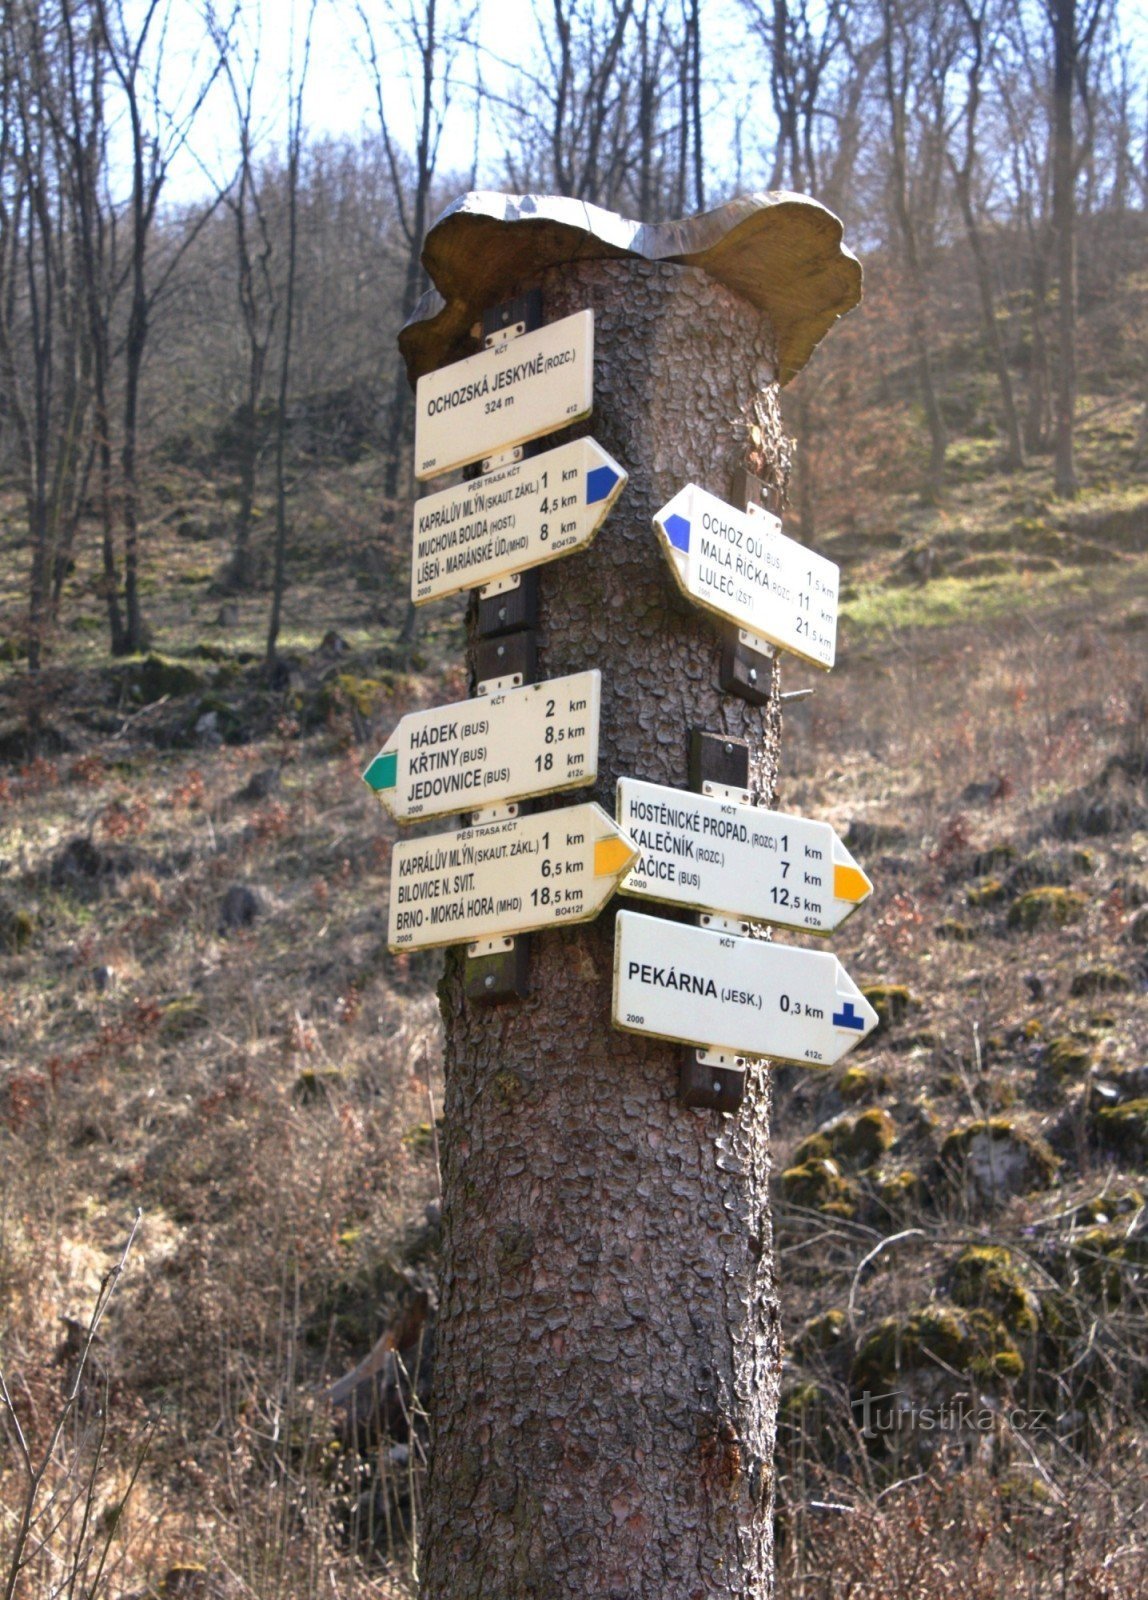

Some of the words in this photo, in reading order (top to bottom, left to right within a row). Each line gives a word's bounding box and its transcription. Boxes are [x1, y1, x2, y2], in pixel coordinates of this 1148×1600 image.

[495, 344, 507, 355] KČT
[427, 374, 489, 416] OCHOZSKÁ
[492, 353, 543, 391] JESKYNĚ
[485, 402, 501, 414] 324
[505, 396, 514, 406] m
[566, 404, 577, 413] 412
[482, 473, 506, 488] TRASA
[507, 467, 520, 479] KČT
[419, 502, 461, 534] KAPRÁLŮV
[463, 494, 484, 515] MLÝN
[541, 472, 548, 488] 1
[562, 468, 577, 482] km
[418, 532, 457, 557] MUCHOVA
[459, 520, 488, 549] BOUDA
[540, 497, 558, 514] 4,5
[562, 495, 577, 508] km
[446, 541, 492, 573] MARIÁNSKÉ
[540, 524, 548, 541] 8
[561, 521, 576, 534] km
[702, 513, 742, 548] OCHOZ
[822, 582, 834, 599] km
[700, 538, 732, 572] MALÁ
[736, 554, 769, 590] ŘÍČKA
[798, 592, 810, 611] 11
[820, 608, 833, 624] km
[699, 564, 734, 597] LULEČ
[819, 633, 832, 649] km
[410, 722, 457, 749] HÁDEK
[460, 720, 489, 740] (BUS)
[546, 700, 555, 717] 2
[569, 698, 587, 712] km
[490, 696, 505, 706] KČT
[409, 749, 459, 775] KŘTINY
[460, 747, 487, 766] (BUS)
[545, 726, 564, 744] 8,5
[568, 725, 585, 739] km
[407, 769, 481, 802] JEDOVNICE
[483, 768, 510, 787] (BUS)
[535, 753, 553, 772] 18
[567, 753, 584, 766] km
[567, 770, 584, 778] 412c
[407, 804, 423, 815] 2000
[475, 826, 500, 838] TRASA
[502, 822, 517, 833] KČT
[630, 800, 700, 832] HOSTĚNICKÉ
[703, 816, 750, 844] PROPAD.
[752, 832, 778, 850] (ROZC.)
[781, 835, 788, 852] 1
[804, 845, 822, 860] km
[720, 805, 736, 816] KČT
[399, 848, 447, 877] KAPRÁLŮV
[449, 844, 474, 867] MLÝN
[510, 839, 539, 857] ZÁKL.)
[542, 832, 550, 850] 1
[566, 832, 584, 846] km
[630, 828, 694, 858] KALEČNÍK
[695, 848, 725, 868] (ROZC.)
[780, 862, 790, 878] 7
[804, 872, 822, 887] km
[398, 879, 440, 904] BILOVICE
[442, 876, 451, 889] N.
[454, 872, 475, 892] SVIT.
[541, 859, 562, 877] 6,5
[566, 861, 584, 873] km
[629, 878, 647, 889] 2000
[632, 855, 675, 881] AČICE
[678, 871, 701, 889] (BUS)
[770, 887, 800, 909] 12,5
[804, 898, 822, 914] km
[396, 911, 423, 930] BRNO
[430, 895, 464, 924] MOKRÁ
[467, 896, 494, 917] HORA
[496, 898, 522, 916] (MHD)
[531, 886, 561, 906] 18,5
[565, 888, 583, 901] km
[396, 934, 413, 943] 2005
[719, 938, 735, 948] KČT
[628, 961, 717, 999] PEKÁRNA
[721, 988, 762, 1010] (JESK.)
[780, 994, 801, 1016] 0,3
[805, 1004, 824, 1019] km
[626, 1014, 644, 1025] 2000
[804, 1049, 822, 1060] 412c
